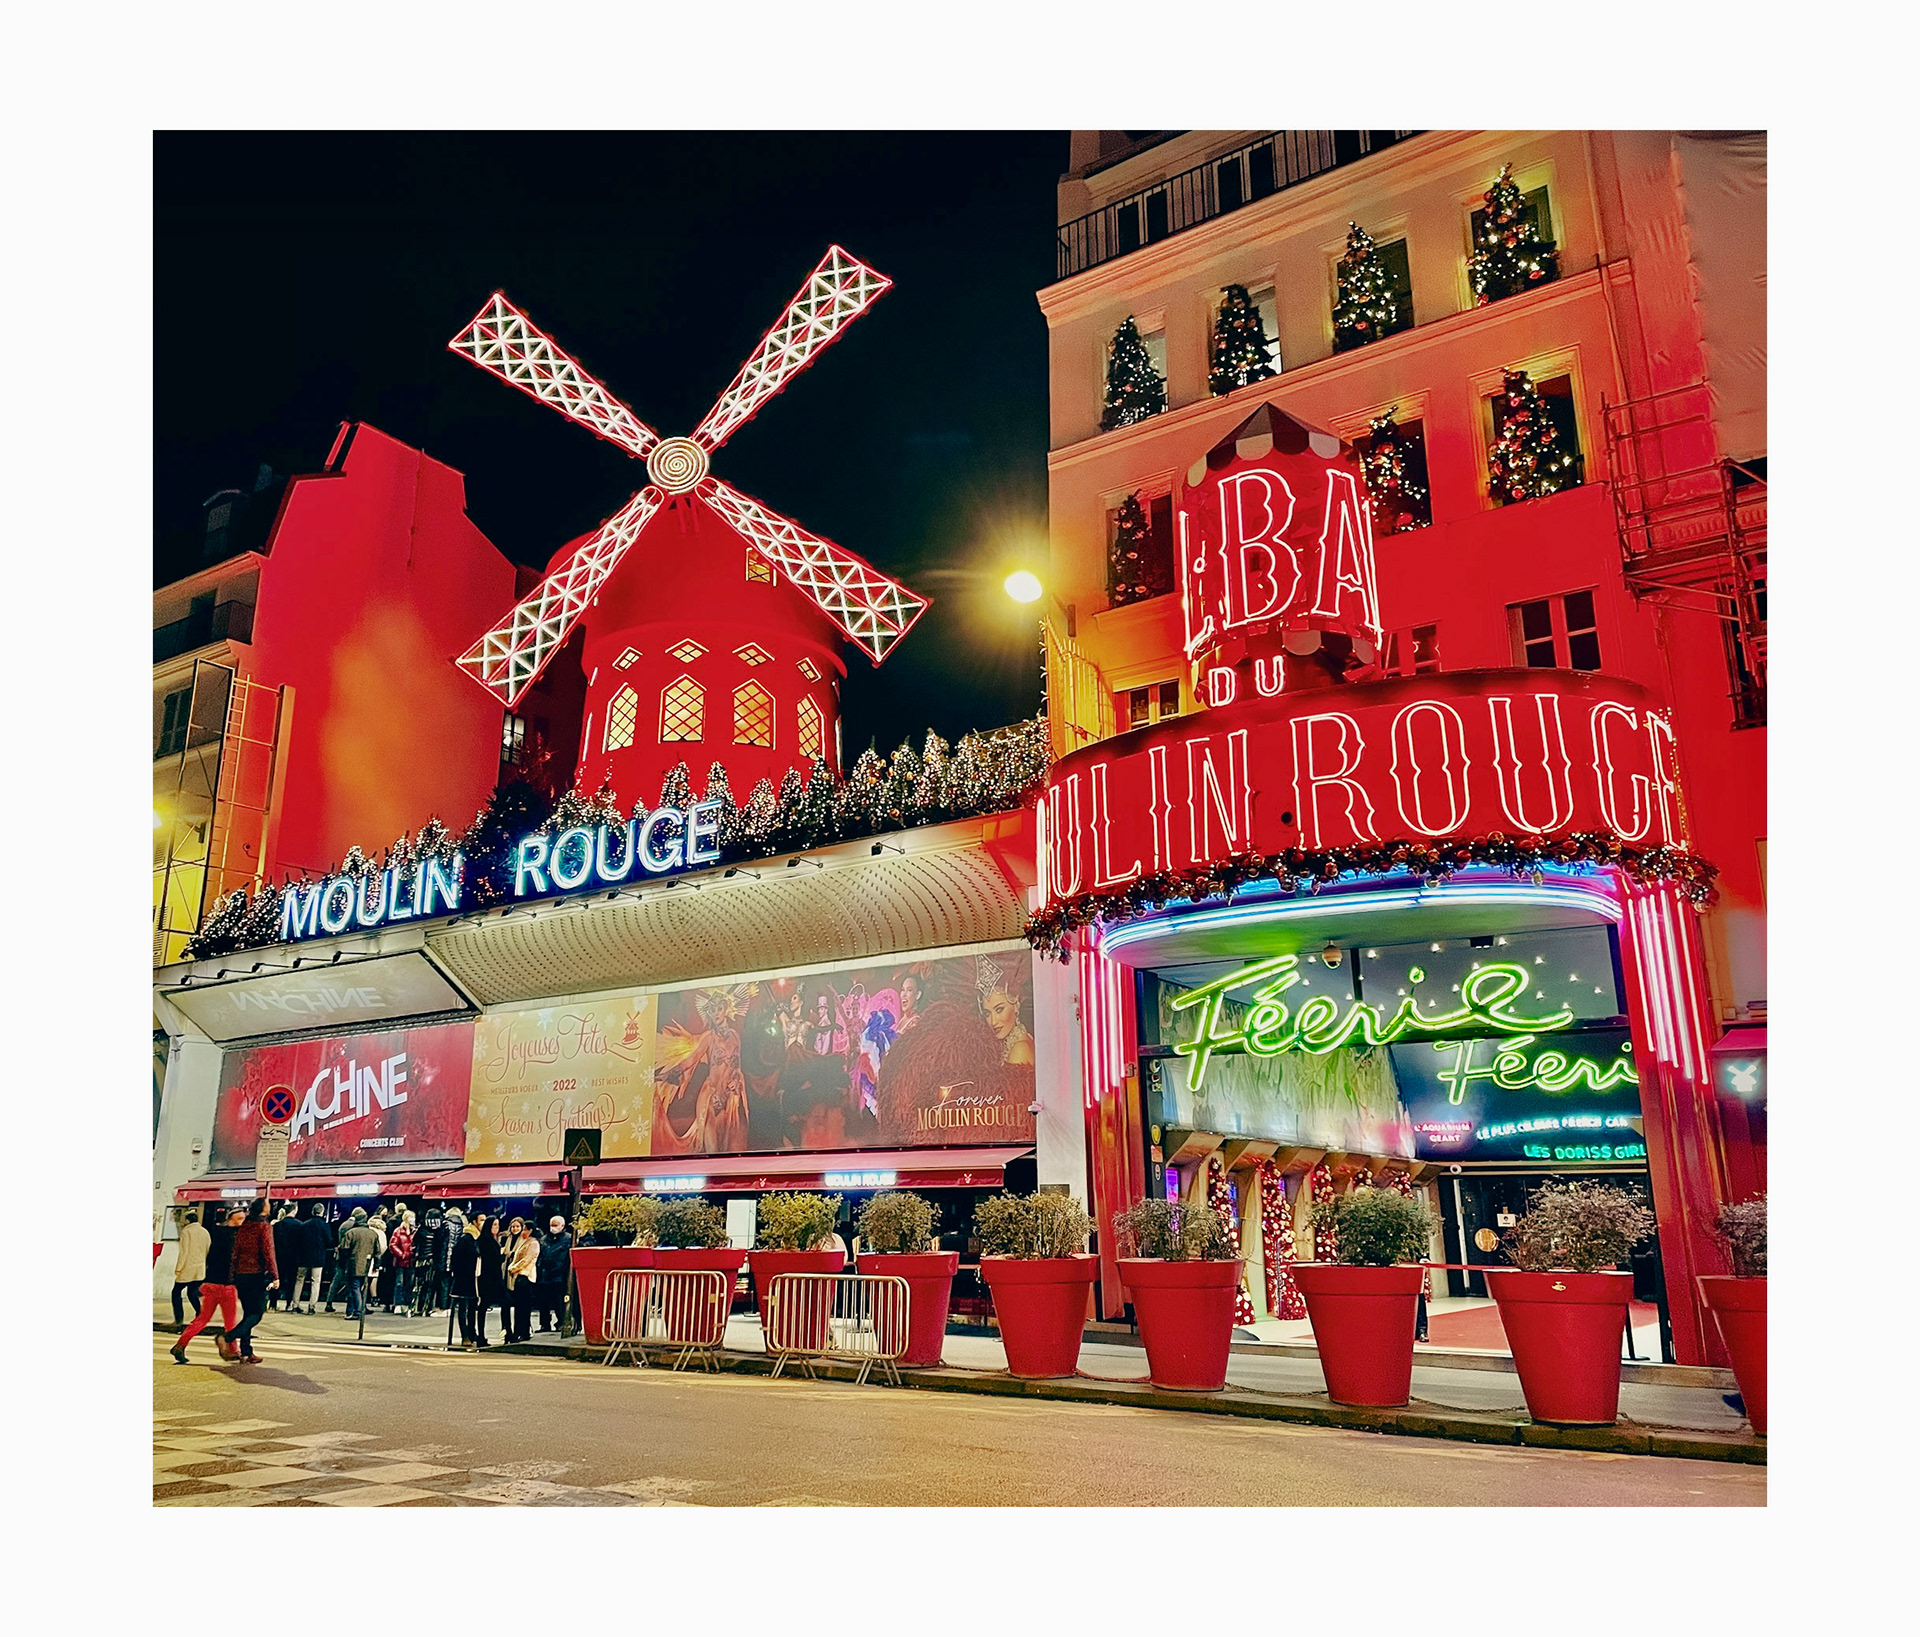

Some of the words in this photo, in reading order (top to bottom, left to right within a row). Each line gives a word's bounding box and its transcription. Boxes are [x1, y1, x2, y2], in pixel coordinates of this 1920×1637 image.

[1208, 656, 1285, 706] DU
[281, 850, 464, 941] MOULIN
[514, 799, 723, 898] ROUGE
[1172, 954, 1574, 1091] Féerie
[478, 1021, 562, 1083] Joyeuses
[553, 1078, 577, 1092] 2022
[591, 1077, 605, 1087] BEST
[605, 1076, 629, 1086] WISHES
[931, 1080, 1004, 1115] Forever
[486, 1096, 543, 1137] Season's
[917, 1104, 970, 1131] MOULIN
[973, 1102, 1026, 1126] ROUGE
[1413, 1122, 1471, 1132] L'AQUARIUM
[359, 1137, 389, 1149] CONCERTS
[388, 1136, 405, 1147] CLUB
[1475, 1126, 1491, 1141] LE
[1490, 1122, 1517, 1138] PLUS
[1523, 1144, 1551, 1158] LES
[1554, 1145, 1612, 1160] DORISS
